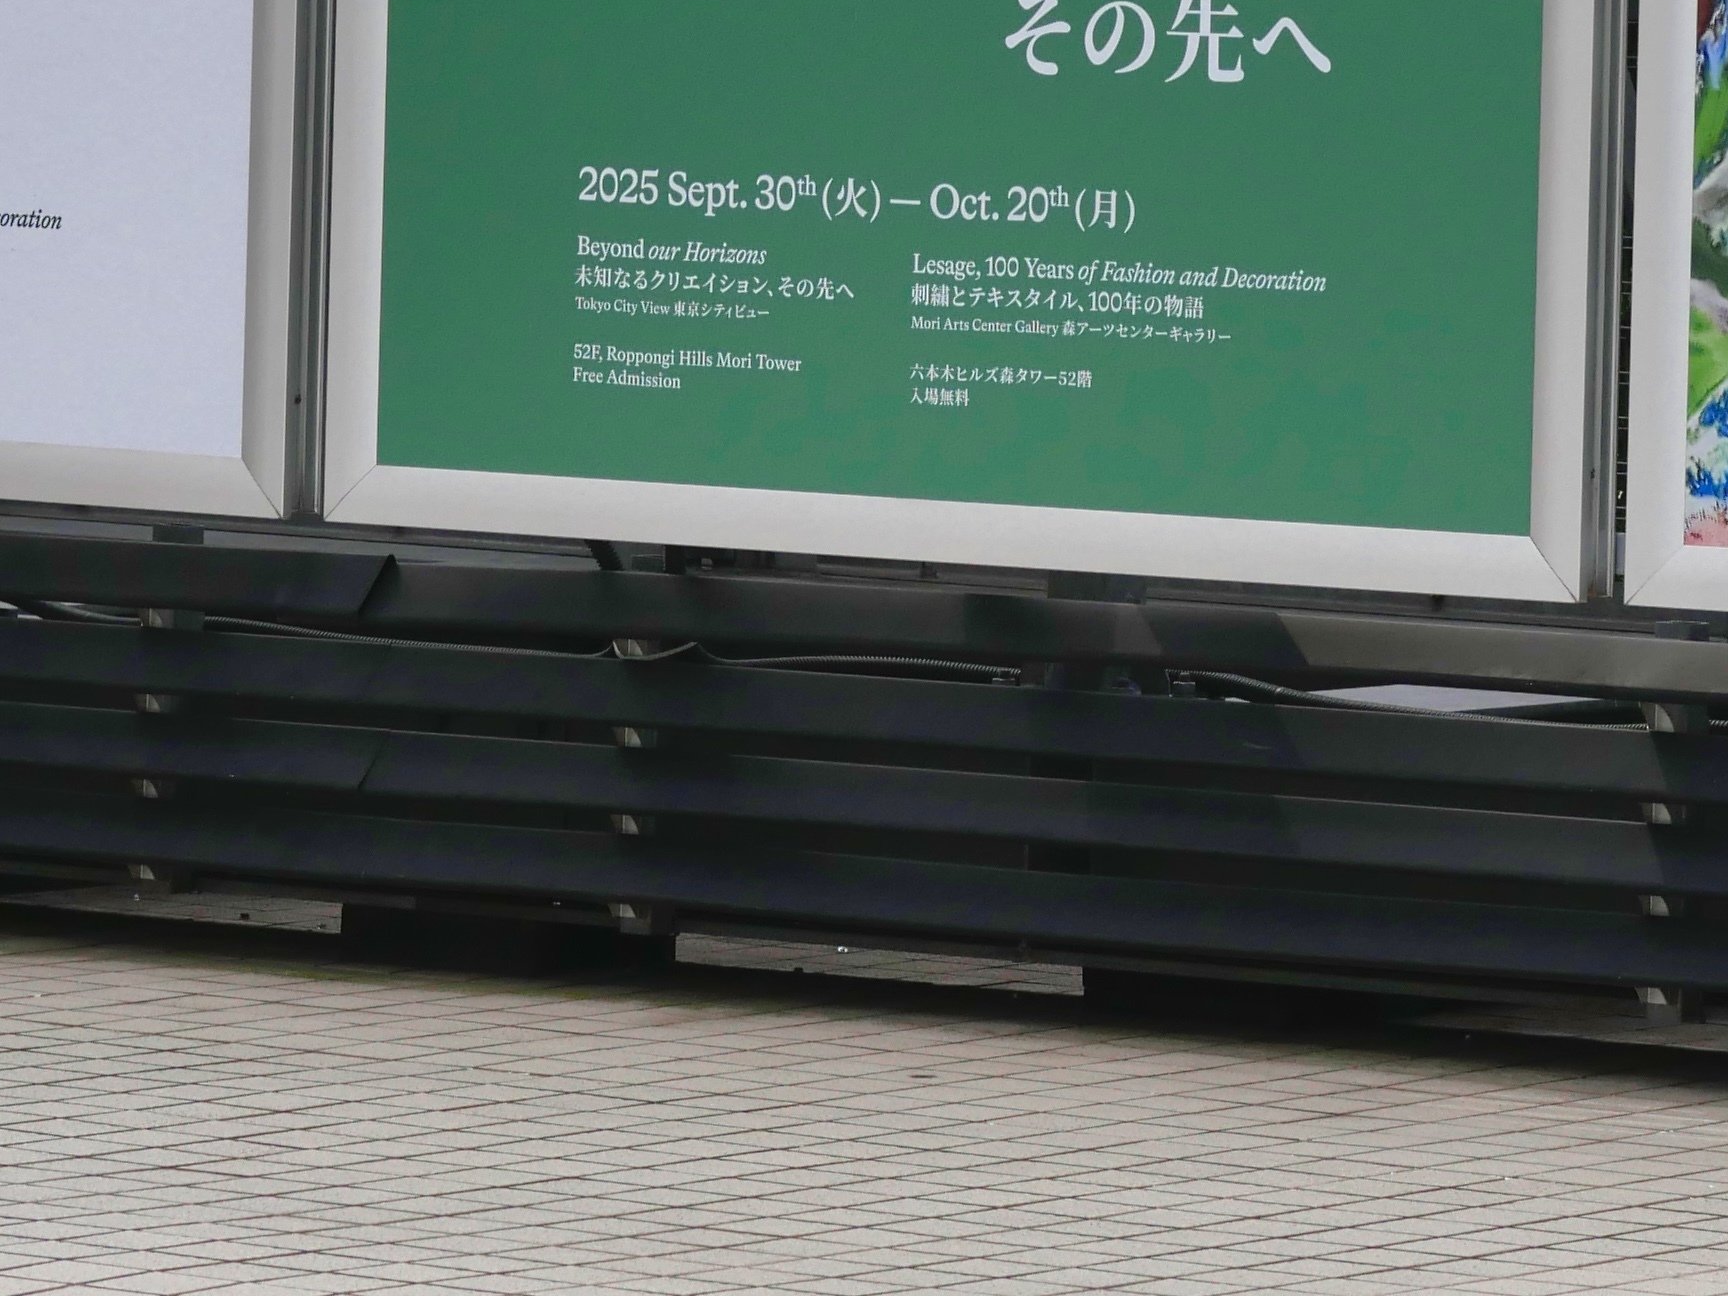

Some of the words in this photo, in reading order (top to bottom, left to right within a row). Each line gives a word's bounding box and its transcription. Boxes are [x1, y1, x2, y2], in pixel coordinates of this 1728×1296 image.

[578, 165, 659, 205] 2025
[667, 170, 747, 217] Sept.
[930, 183, 1000, 221] Oct.
[577, 235, 645, 262] Beyond
[648, 245, 681, 261] our
[683, 241, 768, 265] Horizons
[575, 264, 855, 300] 未知なるクリエイション、その先へ
[913, 252, 981, 281] Lesage,
[984, 255, 1019, 278] 100
[1024, 257, 1074, 280] Years
[1077, 259, 1100, 286] of
[1100, 260, 1176, 285] Fashion
[1178, 266, 1219, 287] and
[1220, 267, 1327, 292] Decoration
[575, 296, 611, 313] Tokyo
[613, 299, 638, 316] City
[640, 300, 670, 315] View
[673, 300, 769, 319] 東京シティビュー
[911, 282, 1204, 319] 刺繍とテキスタイル、100年の物語
[910, 316, 940, 330] Mori
[943, 318, 970, 331] Arts
[972, 318, 1012, 333] Center
[1014, 319, 1059, 338] Gallery
[1062, 320, 1231, 343] 森アーツセンターギャラリー
[573, 343, 603, 363] 52F,
[606, 345, 675, 369] Roppongi
[679, 350, 713, 367] Hills
[715, 352, 752, 369] Mori
[755, 353, 802, 372] Tower
[573, 366, 603, 384] Free
[606, 369, 681, 389] Admission
[910, 362, 1093, 388] 六本木ヒルズ森タワー52階
[910, 387, 970, 407] 入場無料
